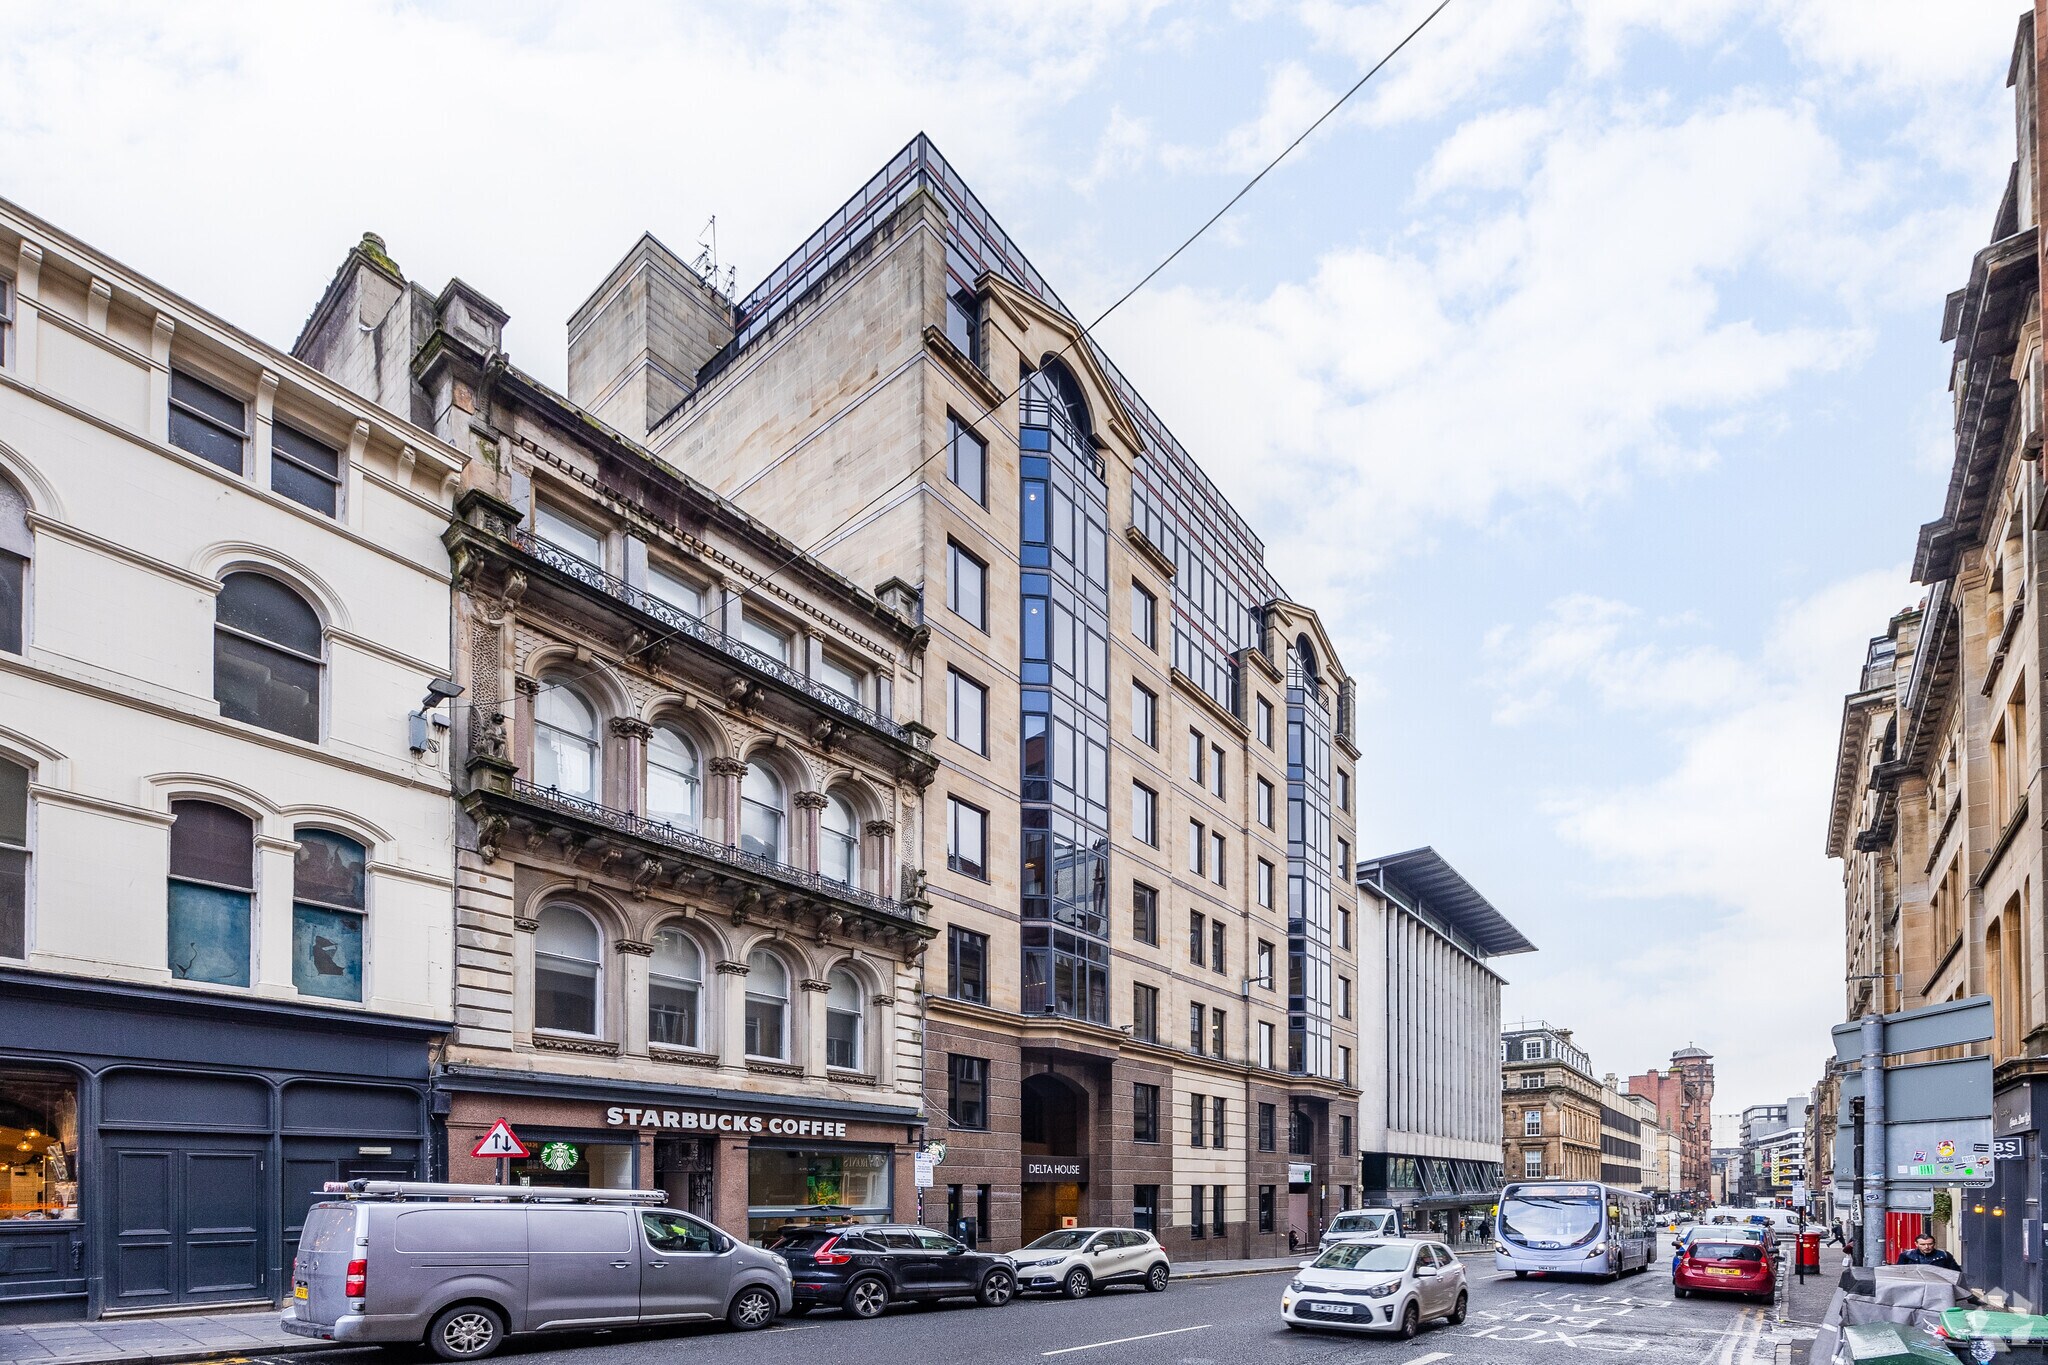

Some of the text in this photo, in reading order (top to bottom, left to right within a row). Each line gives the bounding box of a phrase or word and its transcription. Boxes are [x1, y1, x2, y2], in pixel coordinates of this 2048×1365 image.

[606, 1106, 847, 1138] STARBUCKS COFFEE
[1028, 1163, 1080, 1175] DELTA HOUSE
[1567, 1186, 1587, 1196] 263
[1450, 1325, 1649, 1353] EXCE
